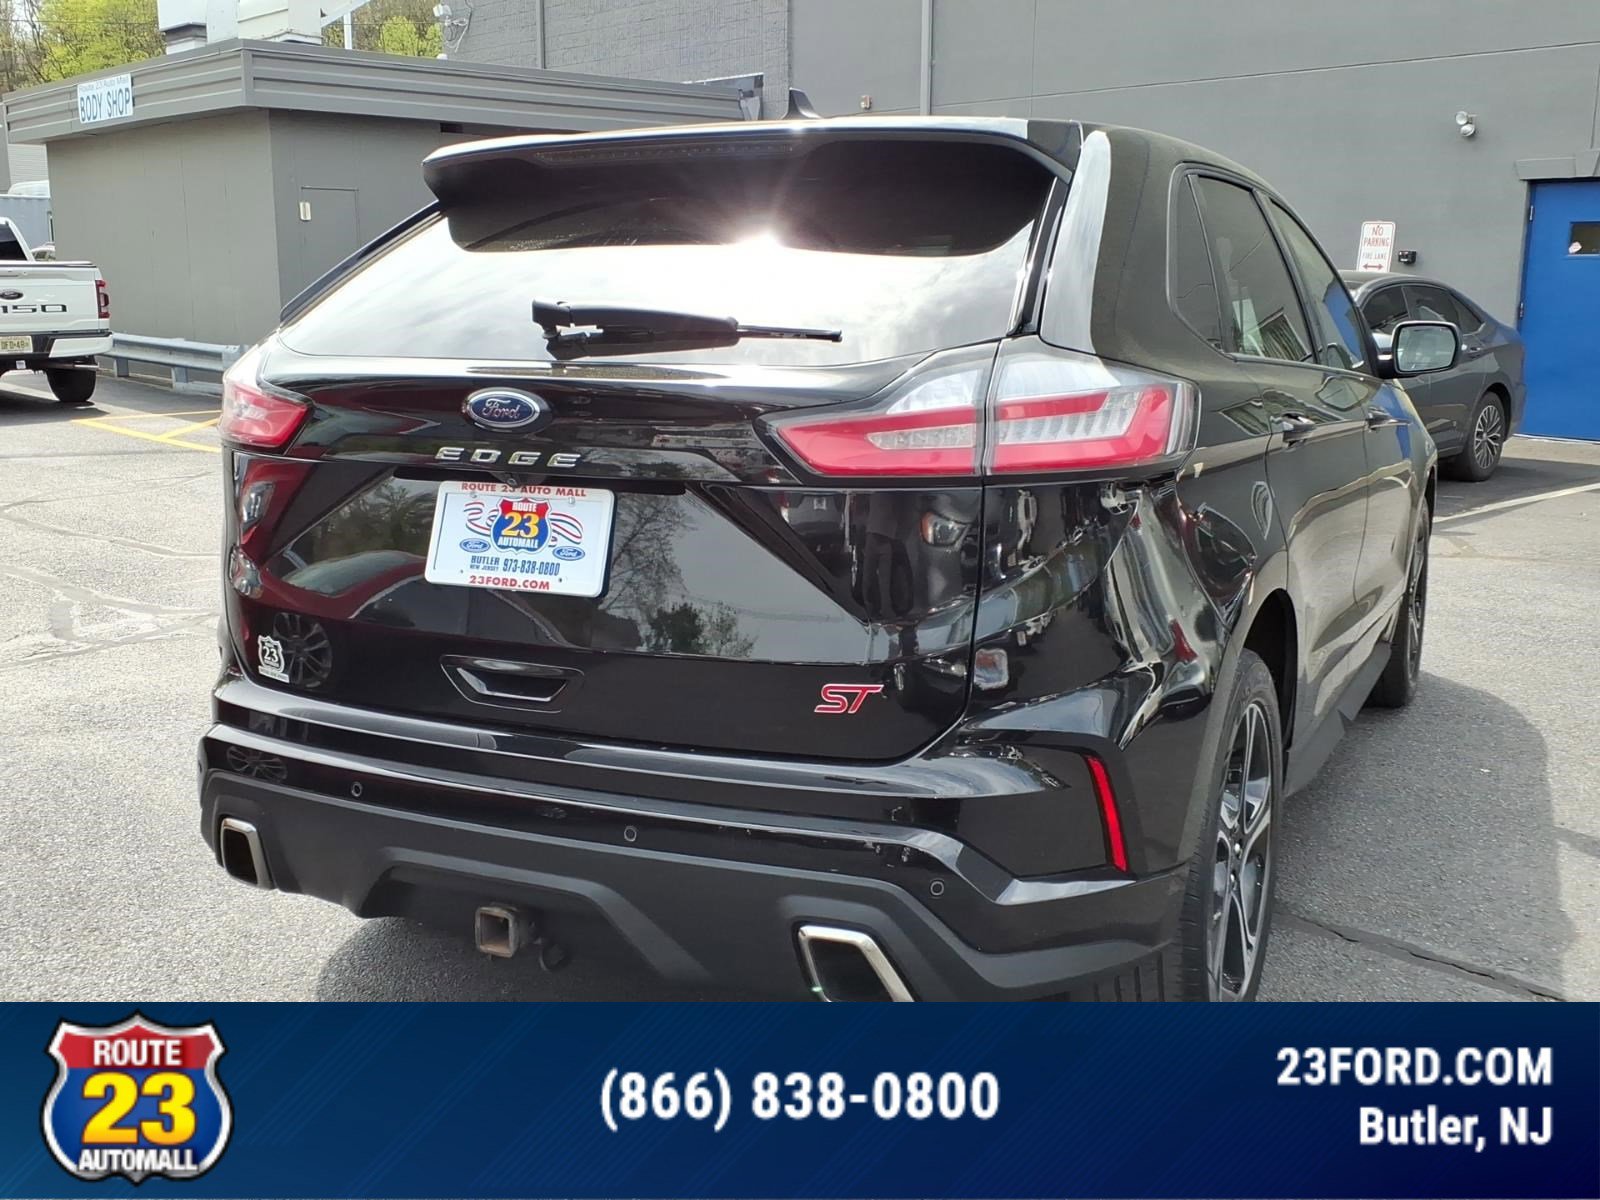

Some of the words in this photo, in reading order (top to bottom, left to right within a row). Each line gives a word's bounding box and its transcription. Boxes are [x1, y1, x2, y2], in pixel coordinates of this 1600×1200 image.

[80, 92, 103, 122] BODY
[106, 87, 131, 118] SHOP
[1372, 225, 1384, 236] NO
[1363, 237, 1390, 247] PARKING
[1374, 252, 1387, 260] LANE
[481, 398, 521, 419] Ford
[434, 446, 581, 468] EDGE
[461, 482, 497, 492] ROUTE
[502, 483, 516, 492] 23
[520, 485, 552, 495] AUTO
[556, 486, 587, 497] MALL
[512, 502, 537, 512] ROUTE
[501, 512, 540, 538] 23
[497, 536, 539, 549] AUTOMALL
[470, 555, 500, 566] BUTLER
[502, 559, 560, 576] 973-838-0800
[469, 575, 550, 590] 23FORD.COM
[262, 646, 279, 663] 23
[814, 683, 884, 714] ST
